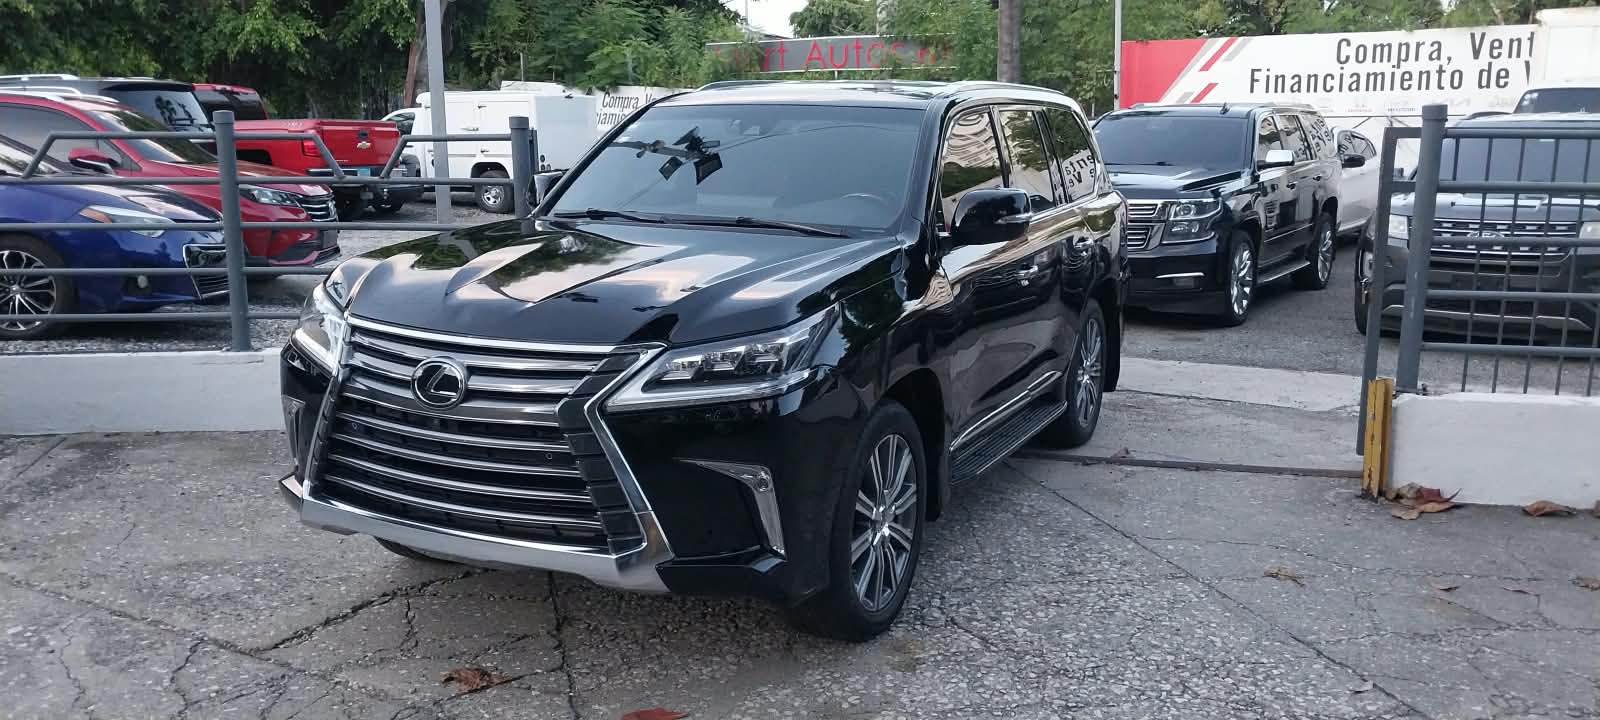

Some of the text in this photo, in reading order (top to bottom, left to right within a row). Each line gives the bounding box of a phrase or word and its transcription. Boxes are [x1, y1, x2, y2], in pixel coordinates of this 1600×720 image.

[1336, 38, 1452, 69] Compra,
[1249, 64, 1464, 94] Financiamiento
[1477, 61, 1510, 89] de
